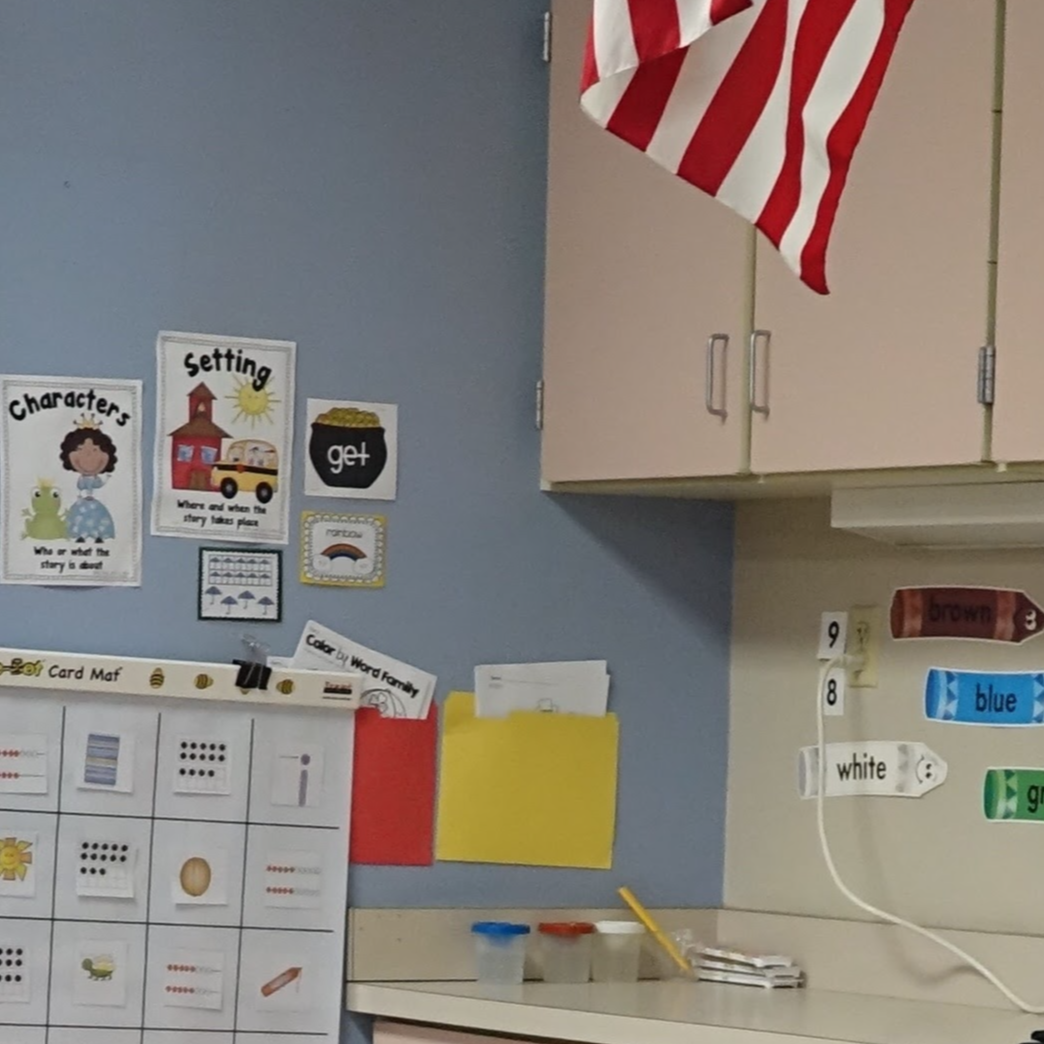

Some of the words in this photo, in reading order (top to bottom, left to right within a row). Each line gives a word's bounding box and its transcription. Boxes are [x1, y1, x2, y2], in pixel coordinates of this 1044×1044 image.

[184, 348, 272, 392] Setting
[9, 388, 131, 427] Characters
[327, 441, 370, 474] get
[177, 499, 205, 510] Where
[208, 503, 225, 512] and
[227, 504, 250, 513] when
[253, 505, 266, 515] the
[184, 513, 207, 528] story
[210, 515, 234, 526] takes
[237, 517, 259, 531] place
[326, 528, 363, 539] rainbow
[34, 546, 53, 556] Who
[57, 548, 67, 556] or
[71, 547, 92, 556] what
[96, 548, 110, 557] the
[41, 560, 65, 574] story
[68, 560, 76, 570] is
[79, 560, 103, 570] about
[929, 601, 992, 623] brown
[828, 621, 840, 649] 9
[48, 665, 85, 680] Card
[90, 667, 123, 682] Mat
[306, 634, 336, 656] Color
[336, 648, 350, 668] by
[350, 656, 382, 679] Word
[381, 671, 420, 699] Family
[827, 678, 838, 706] 8
[974, 684, 1018, 713] blue
[836, 753, 887, 782] white
